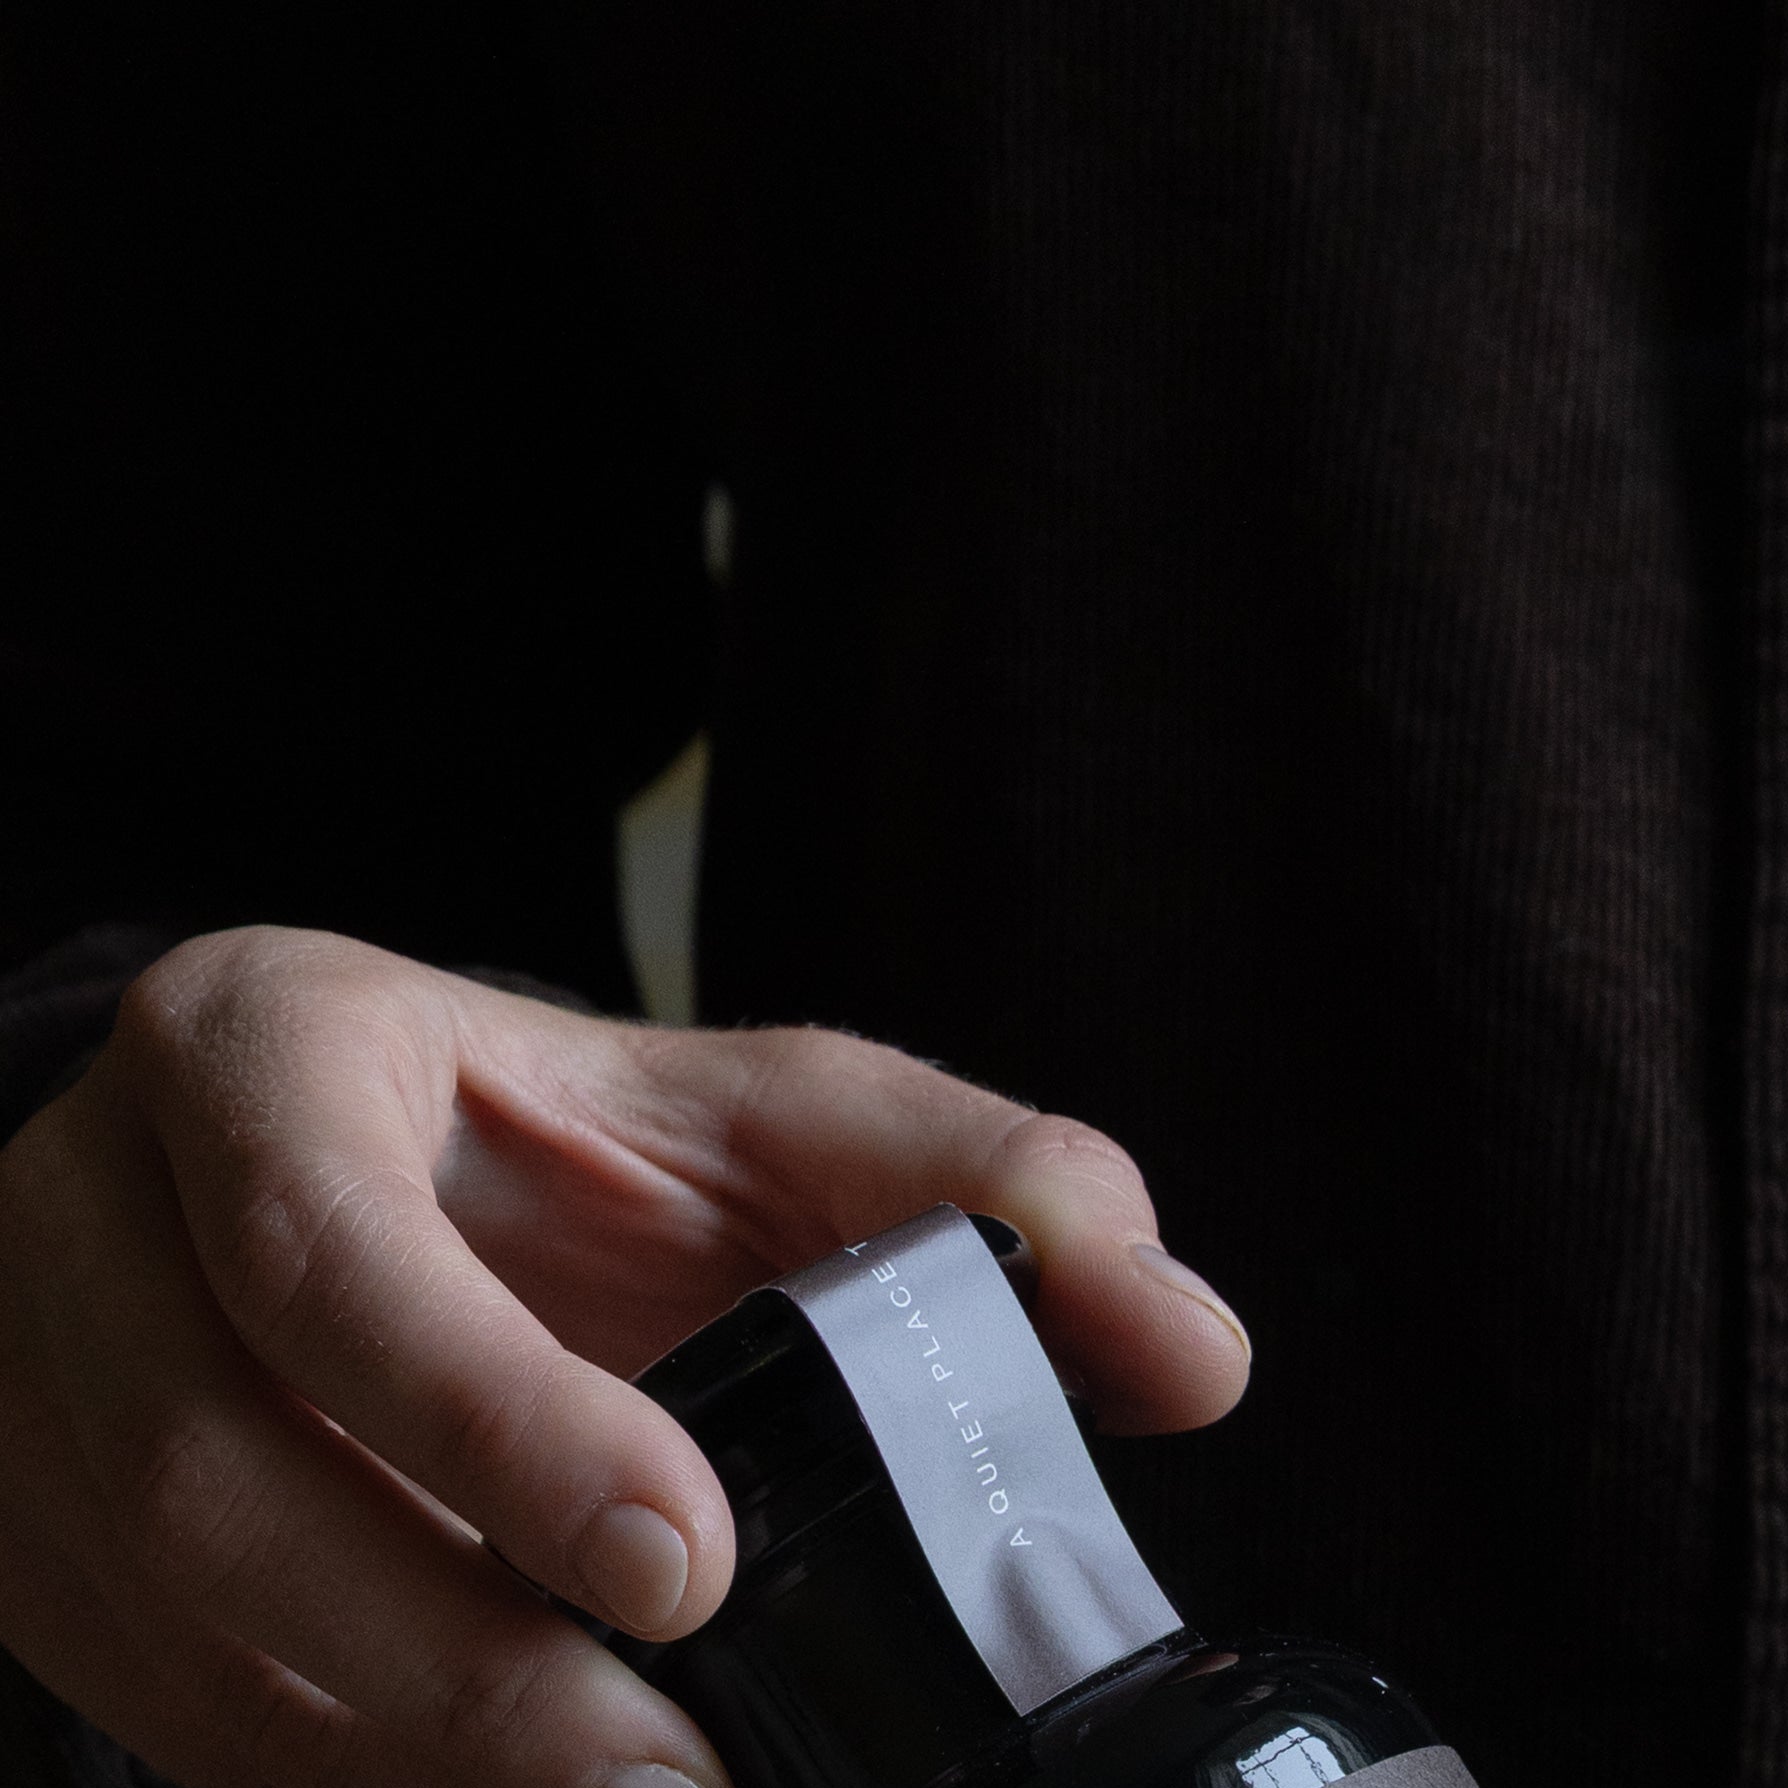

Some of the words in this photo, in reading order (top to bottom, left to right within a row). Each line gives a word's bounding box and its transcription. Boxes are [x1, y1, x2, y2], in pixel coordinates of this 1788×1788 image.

[872, 1261, 953, 1382] PLACE
[948, 1402, 1009, 1514] QUIET
[1010, 1528, 1032, 1546] A
